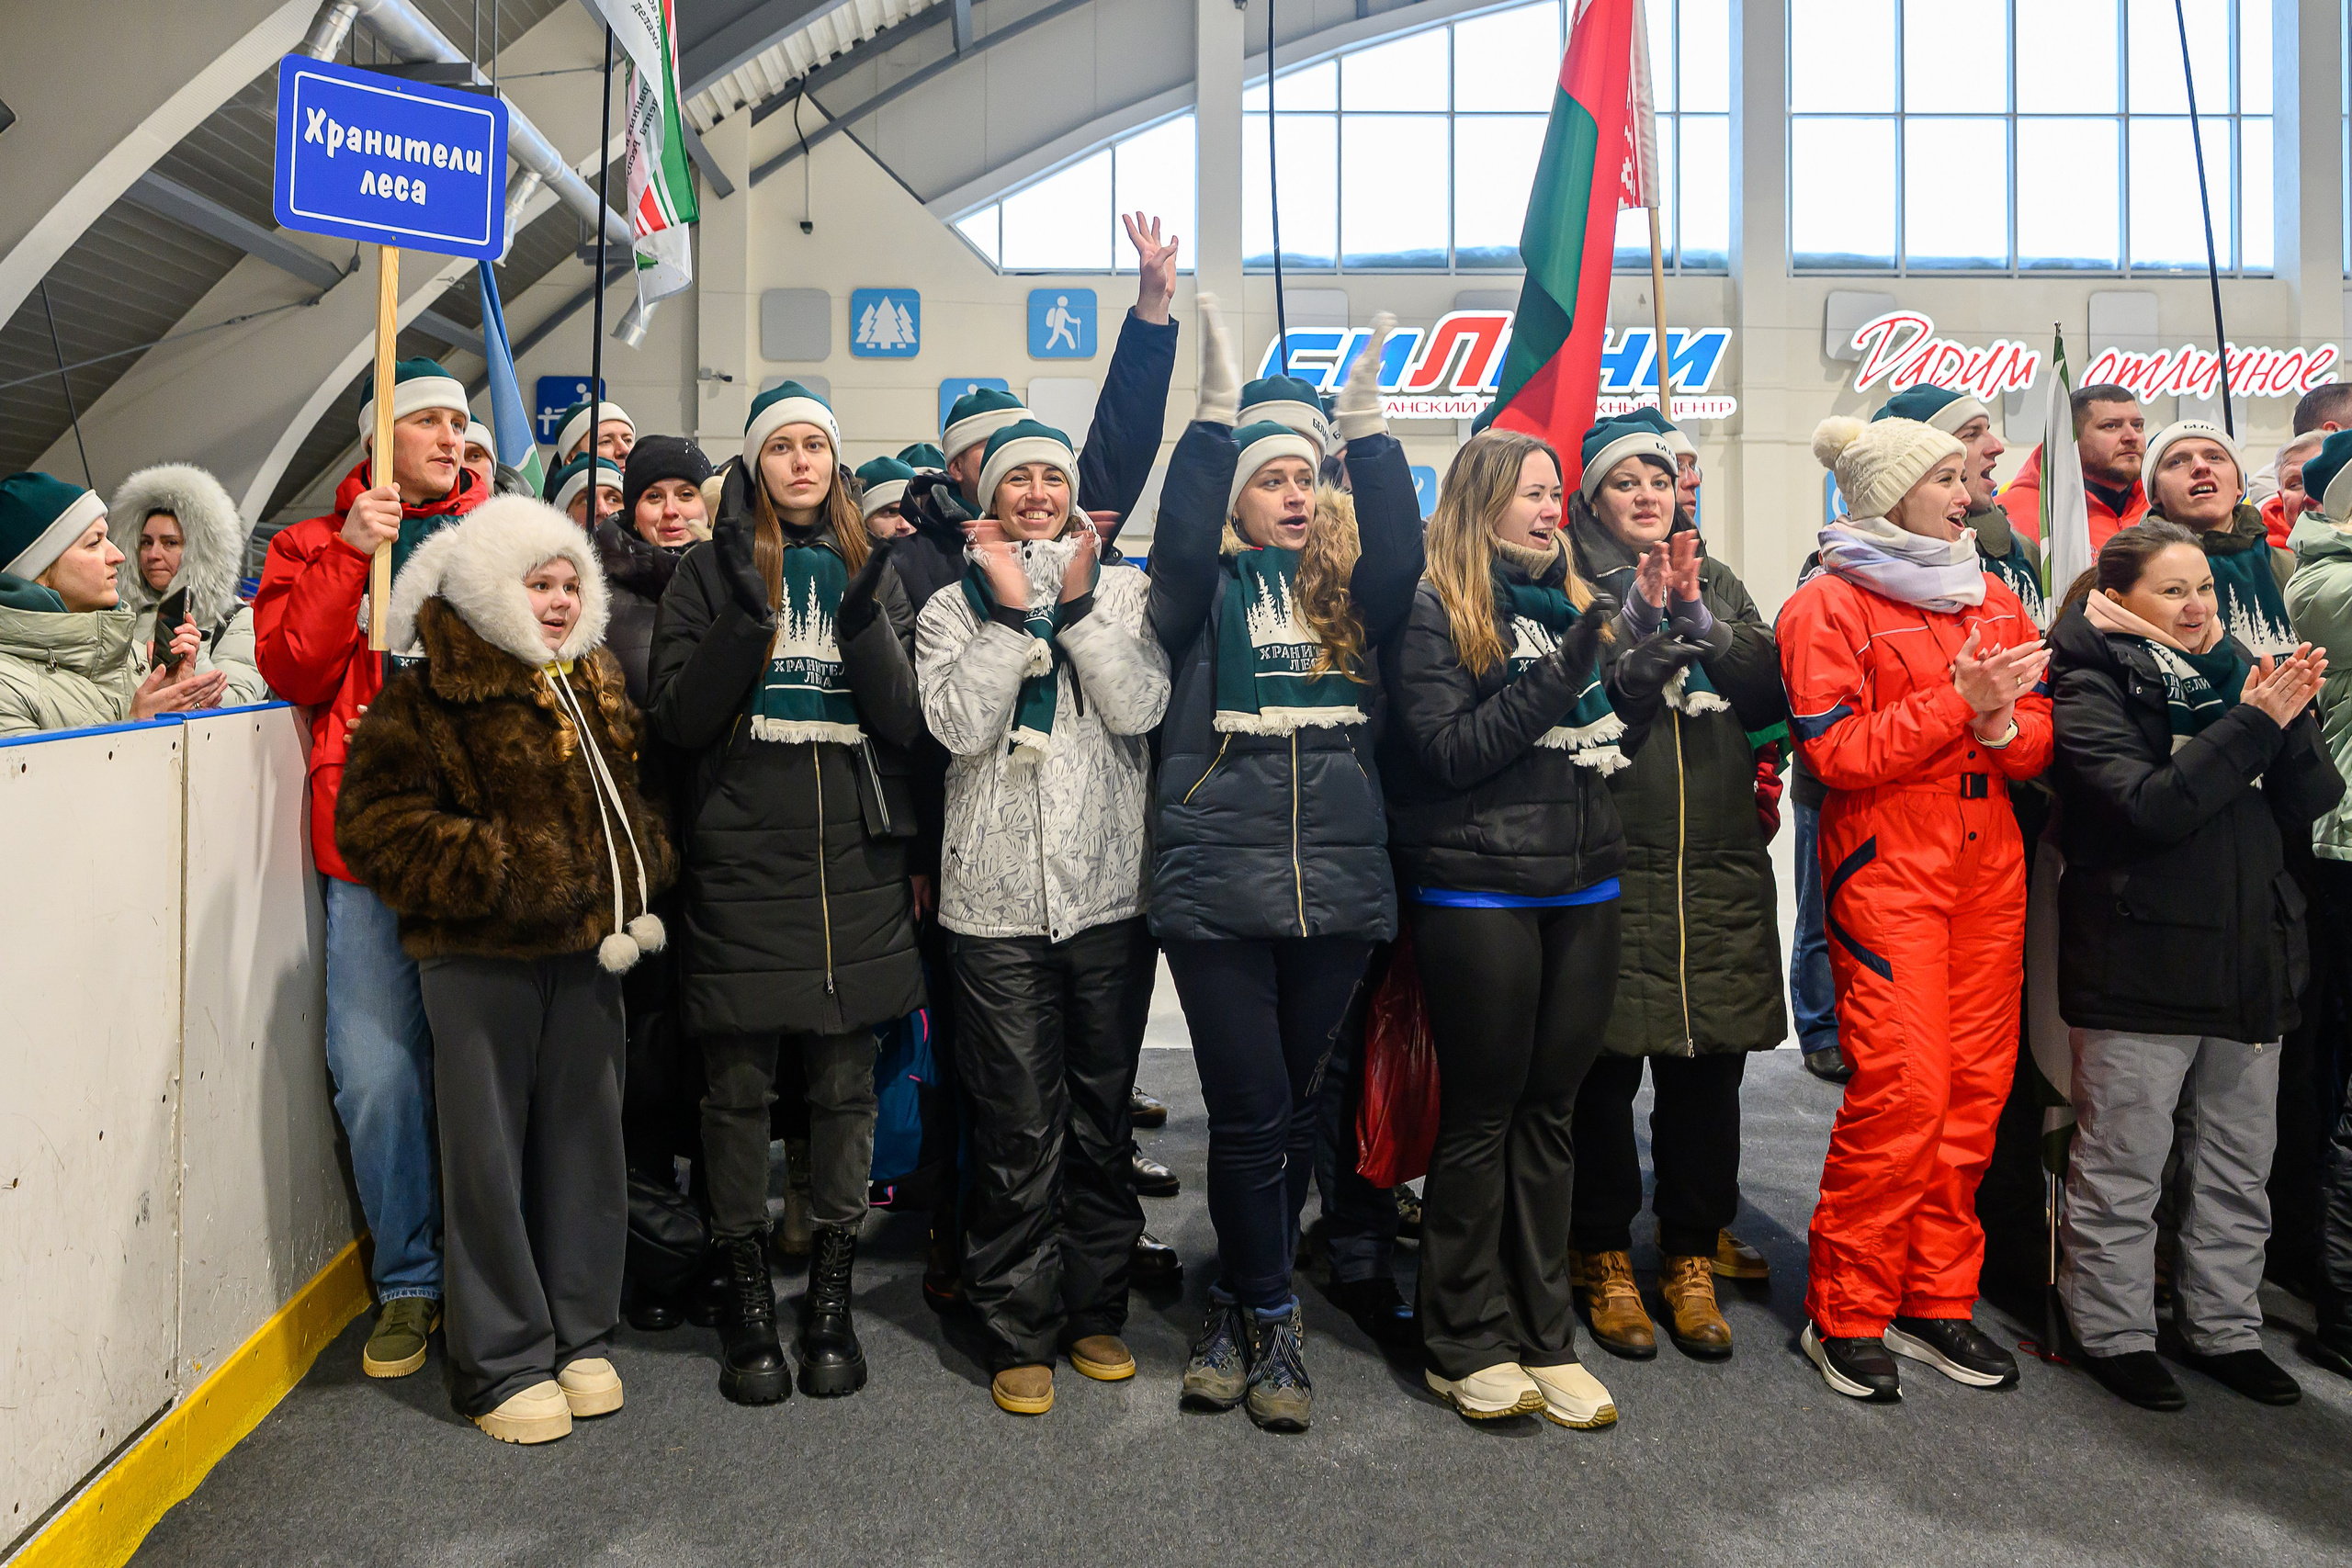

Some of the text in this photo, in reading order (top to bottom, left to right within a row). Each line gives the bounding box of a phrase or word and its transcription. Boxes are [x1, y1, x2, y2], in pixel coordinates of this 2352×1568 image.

[304, 107, 483, 175] Хранители
[359, 169, 427, 206] леса
[1261, 316, 1727, 388] СИЛЧИ
[1856, 316, 2036, 398] Дарим
[2084, 348, 2335, 399] отличное
[1385, 397, 1476, 413] АНСКИЙ
[1259, 644, 1324, 660] ХРАНИТ
